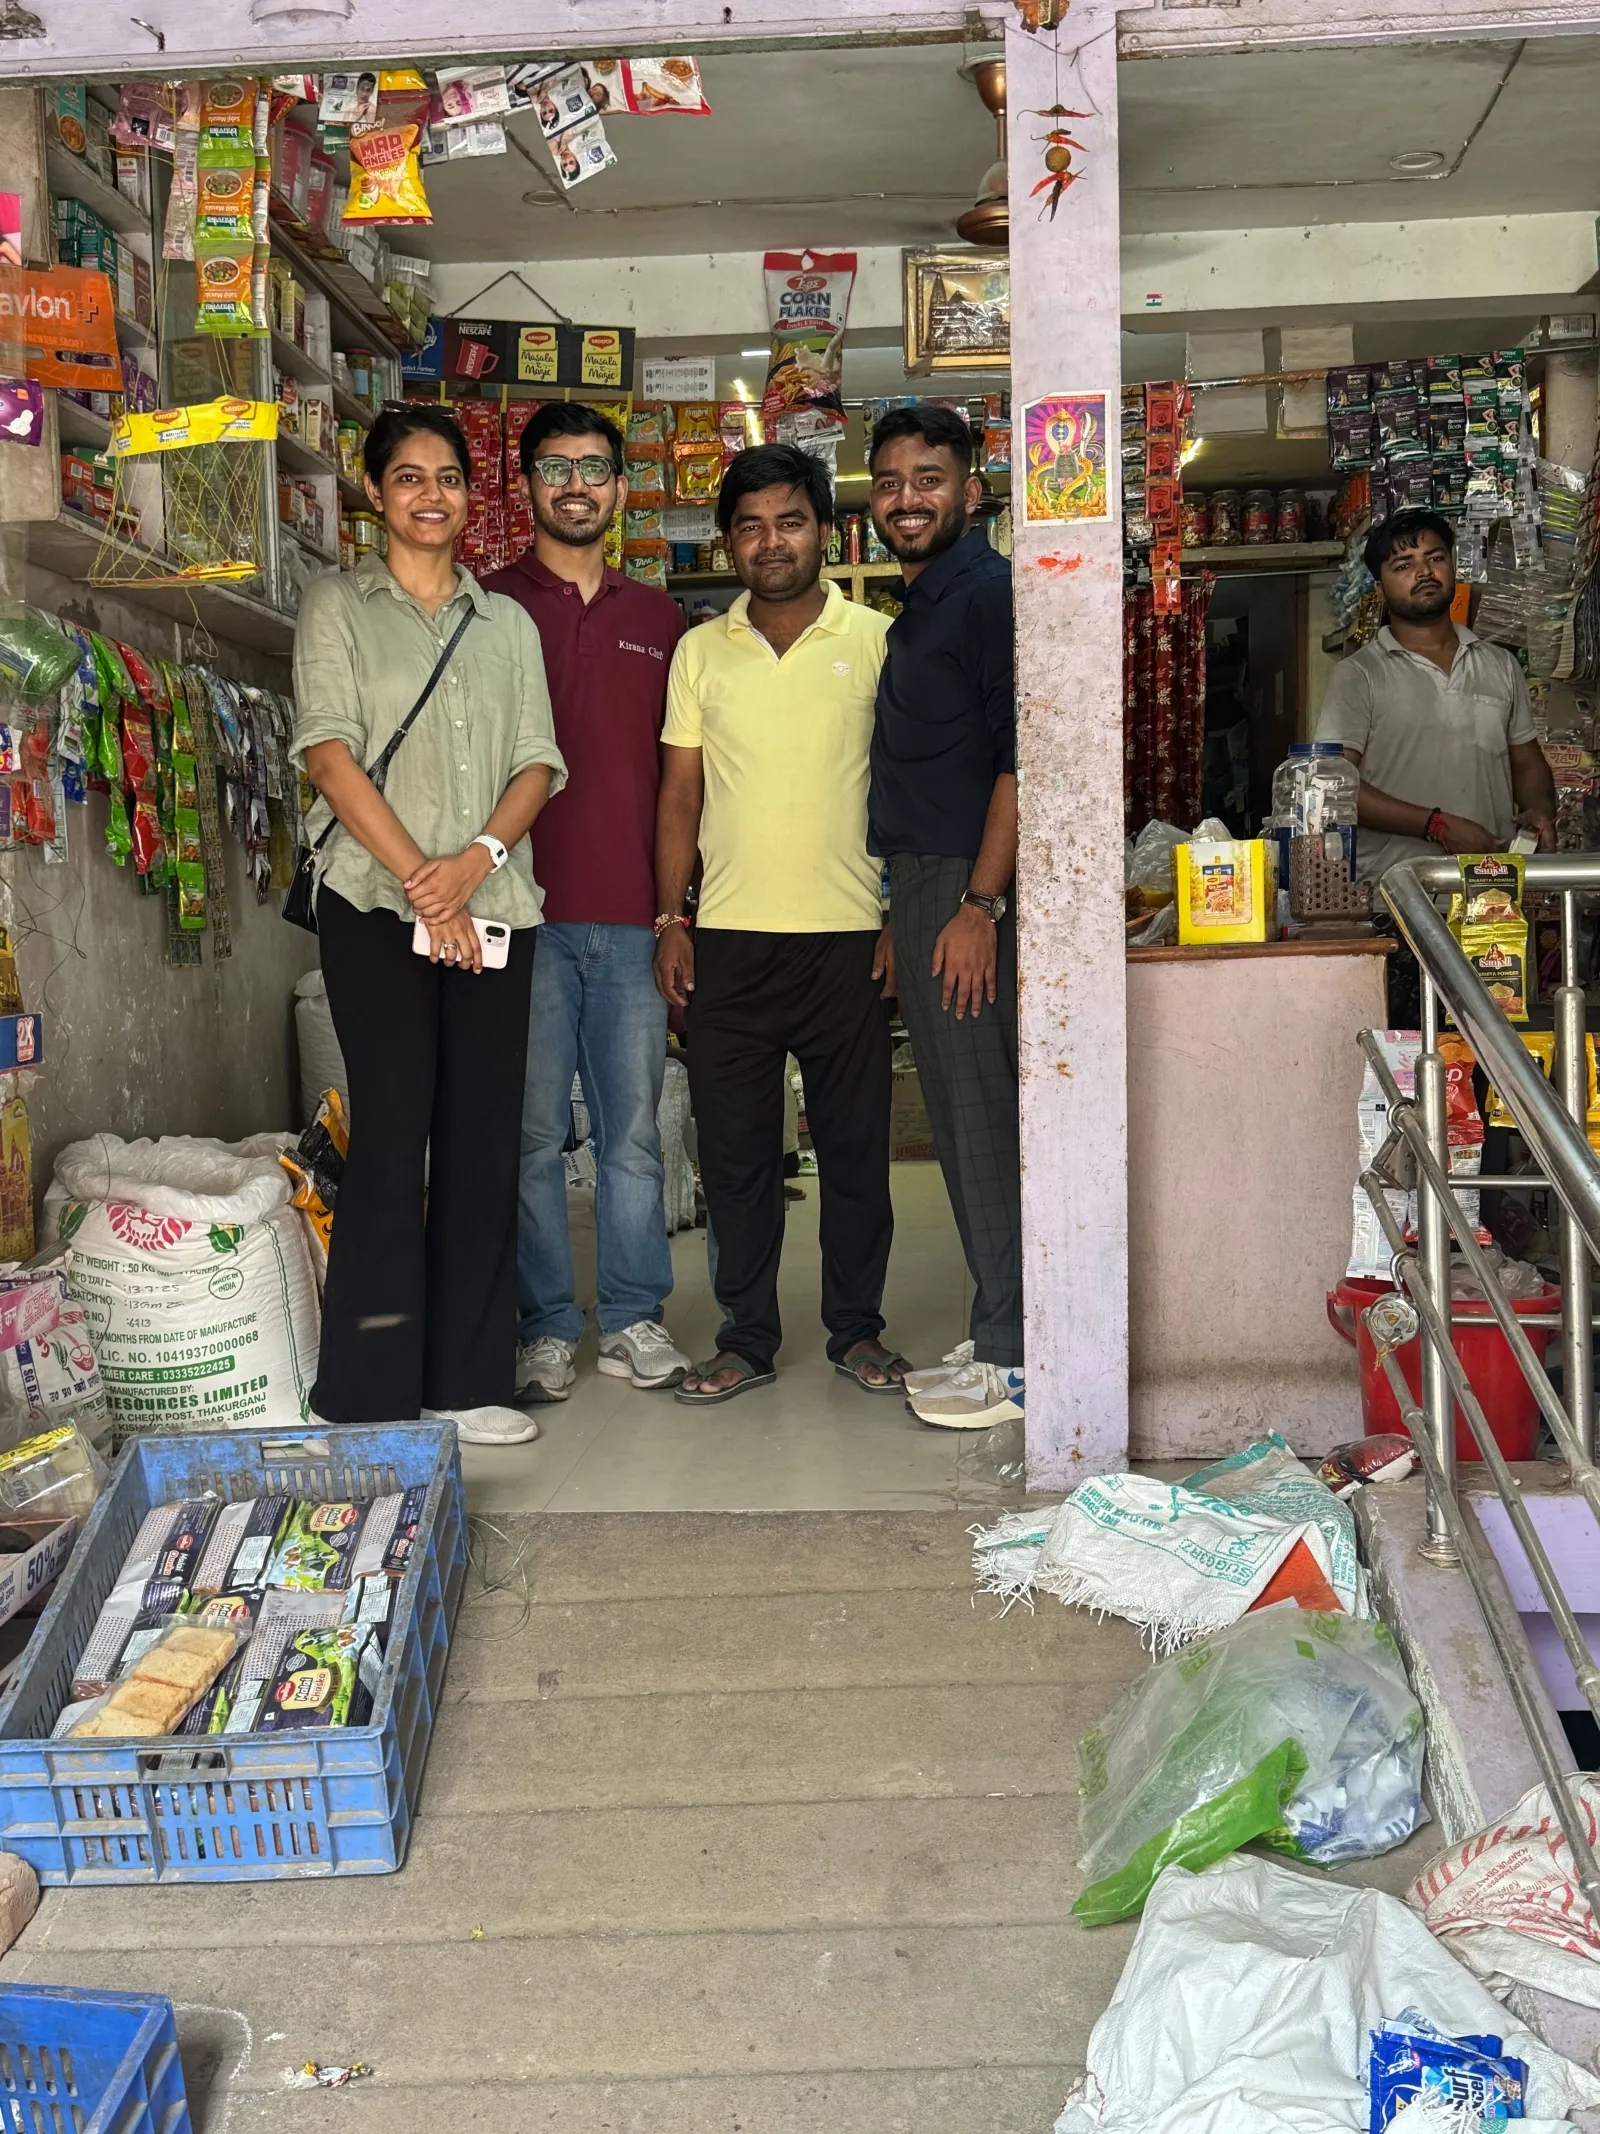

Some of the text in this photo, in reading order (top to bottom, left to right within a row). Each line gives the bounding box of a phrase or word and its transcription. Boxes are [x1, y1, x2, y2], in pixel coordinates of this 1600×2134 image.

[358, 133, 403, 158] MAD
[363, 149, 406, 168] ANGLES
[0, 287, 71, 320] avlon
[780, 292, 831, 306] CORN
[779, 306, 831, 319] FLAKES
[520, 351, 554, 364] Masala
[584, 354, 618, 367] Masala
[524, 364, 552, 380] Magic
[588, 368, 618, 384] Magic
[632, 412, 651, 422] TANG
[632, 461, 652, 472] TANG
[633, 510, 653, 520] TANG
[634, 557, 654, 568] TANG
[618, 639, 664, 660] Kirana Club
[86, 1253, 120, 1273] WEIGHT
[128, 1263, 139, 1273] 50
[218, 1282, 236, 1293] INDIA
[71, 1290, 98, 1303] BATCH
[98, 1293, 115, 1305] NO.
[91, 1312, 107, 1324] NO.
[104, 1332, 137, 1344] MONTHS
[138, 1333, 162, 1344] FROM
[163, 1332, 185, 1343] DATE
[187, 1329, 199, 1340] OF
[199, 1312, 257, 1338] MANUFACTURE
[101, 1330, 259, 1364] LIC. NO. 10419370000068
[23, 1368, 35, 1384] SG
[101, 1369, 126, 1381] OMER
[128, 1369, 154, 1381] CARE
[162, 1360, 230, 1380] 03335222425
[106, 1374, 269, 1410] RESOURCES LIMITED
[109, 1384, 194, 1397] MANUFACTURED BY:
[128, 1411, 163, 1423] CHECK
[197, 1392, 267, 1417] THAKURGANJ
[232, 1405, 267, 1421] 855106
[26, 1541, 56, 1592] 50%
[295, 1676, 314, 1703] Malai
[310, 1671, 327, 1703] Chaska
[1496, 1847, 1529, 1871] KANPUR
